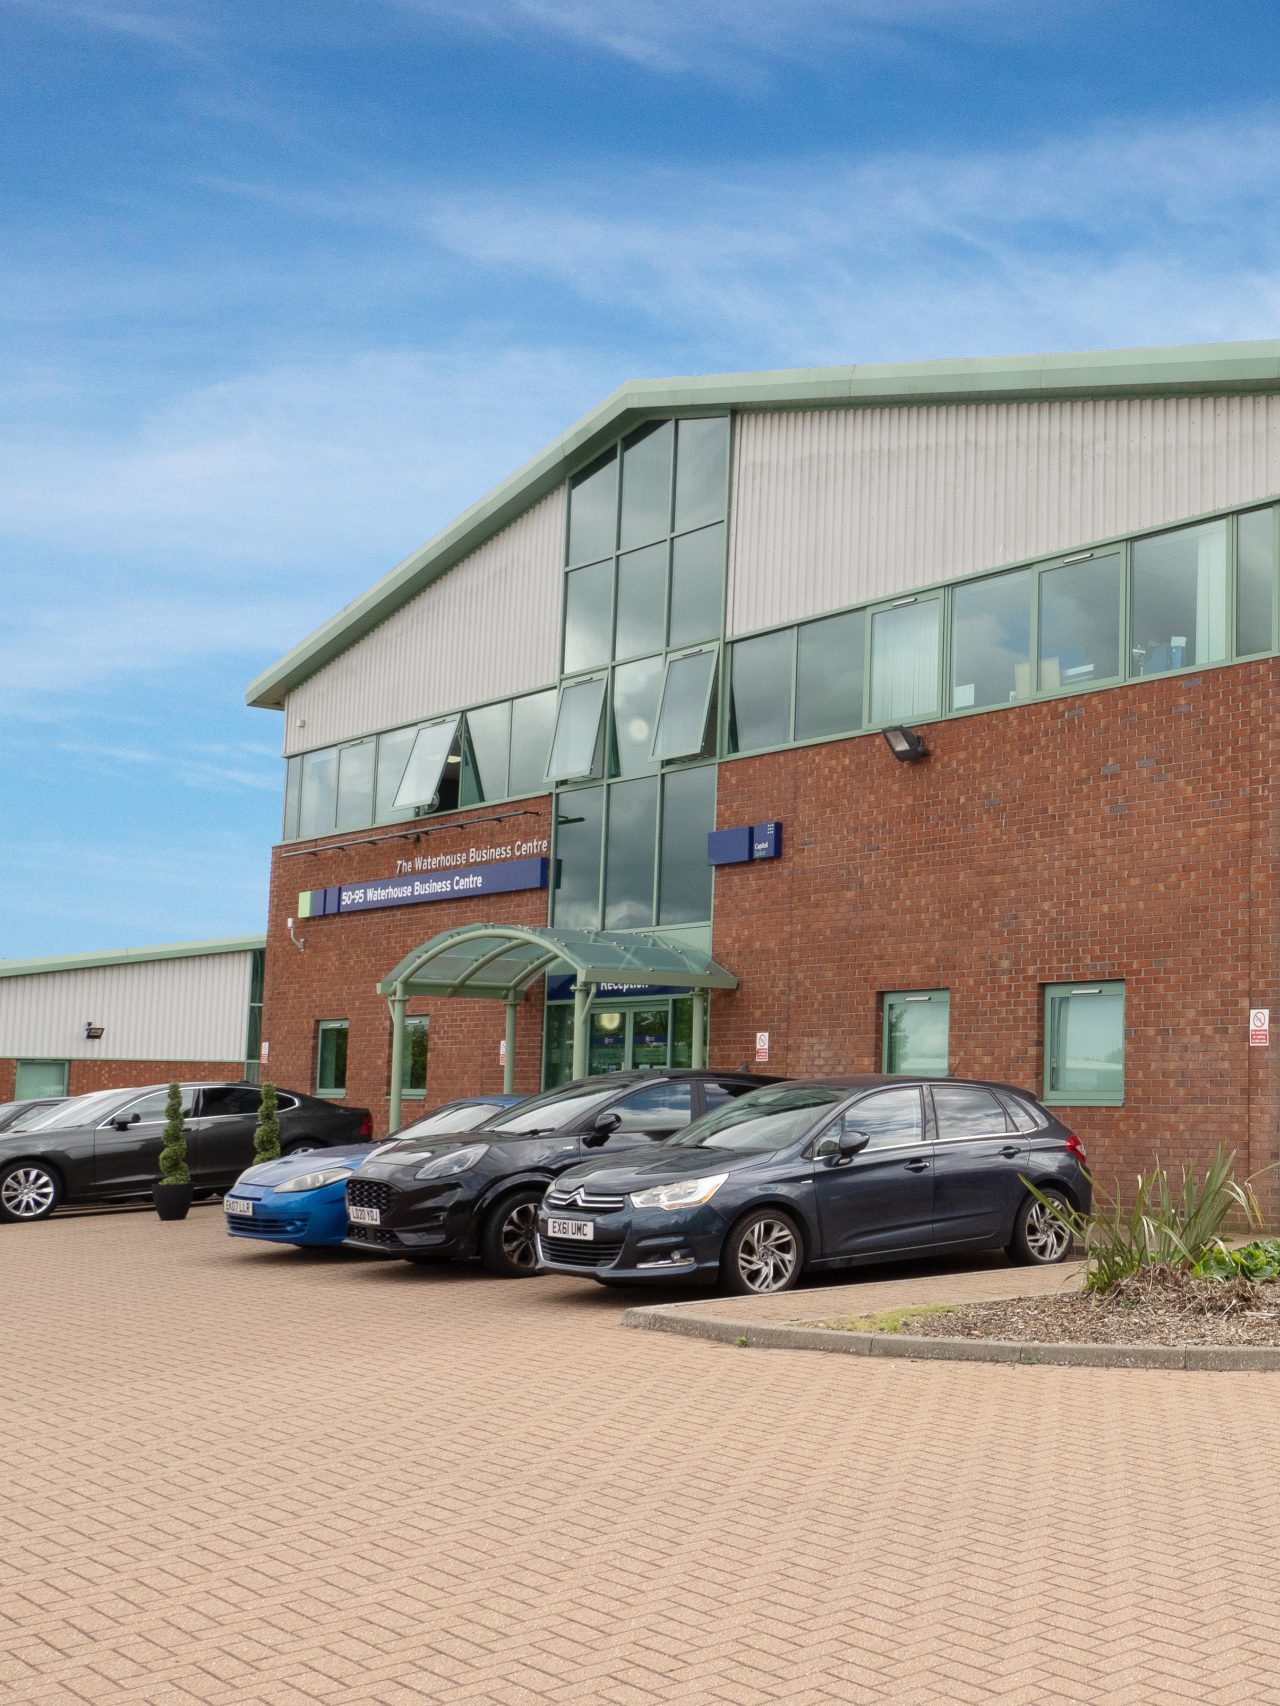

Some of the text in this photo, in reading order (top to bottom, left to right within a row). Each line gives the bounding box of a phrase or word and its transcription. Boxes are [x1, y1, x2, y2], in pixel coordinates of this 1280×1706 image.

[396, 839, 548, 874] The Waterhouse Business Centre
[754, 841, 769, 850] Capital
[342, 874, 483, 905] 50-95 Waterhouse Business Centre
[552, 1221, 588, 1236] EX61 UMC
